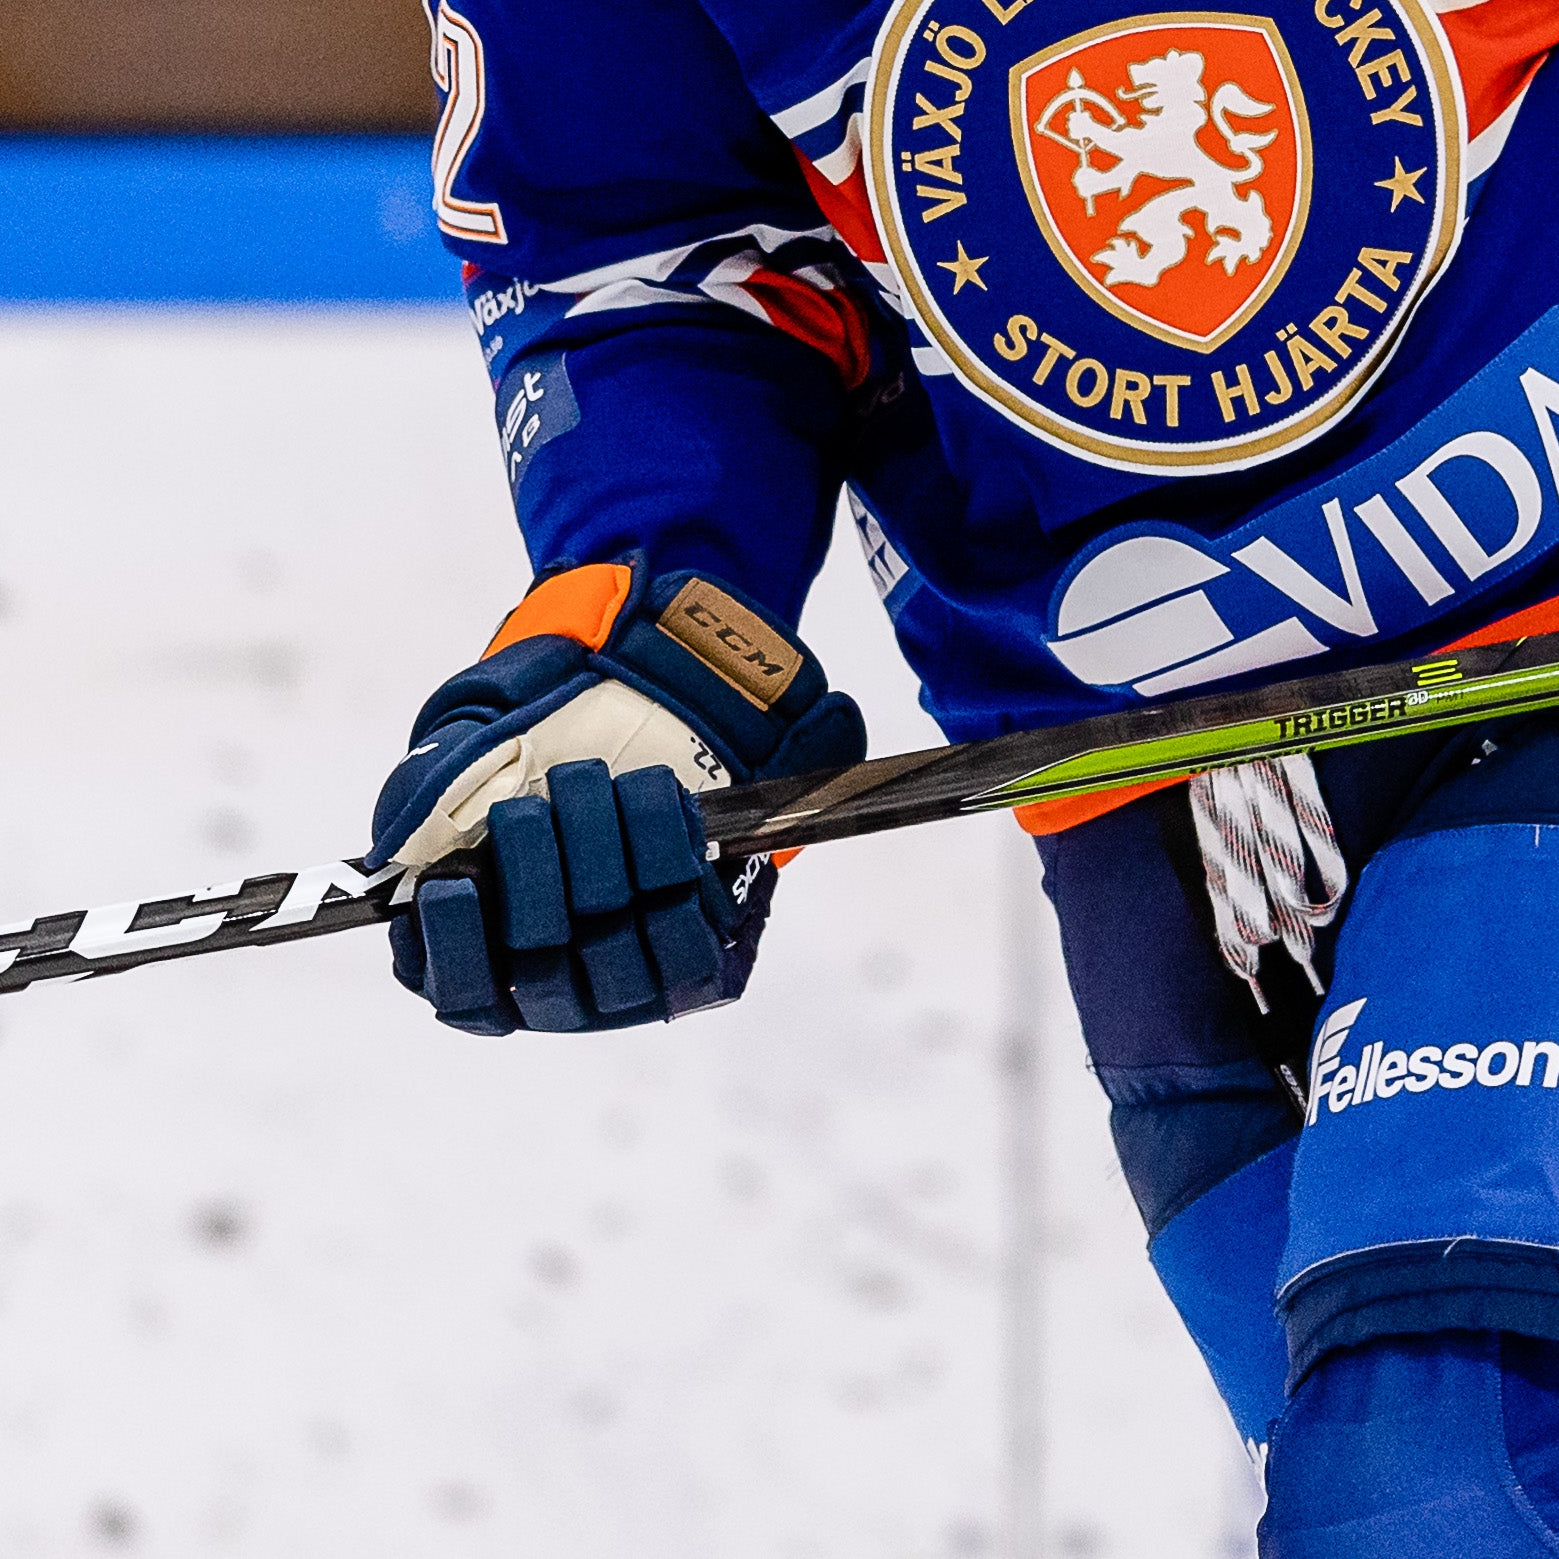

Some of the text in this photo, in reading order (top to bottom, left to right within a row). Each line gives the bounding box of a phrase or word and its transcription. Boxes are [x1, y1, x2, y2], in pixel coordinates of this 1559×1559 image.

[901, 20, 987, 224] VÄXJÖ
[992, 244, 1414, 428] STORT HJÄRTA
[683, 600, 786, 678] CCM
[1273, 696, 1408, 740] TRIGGER
